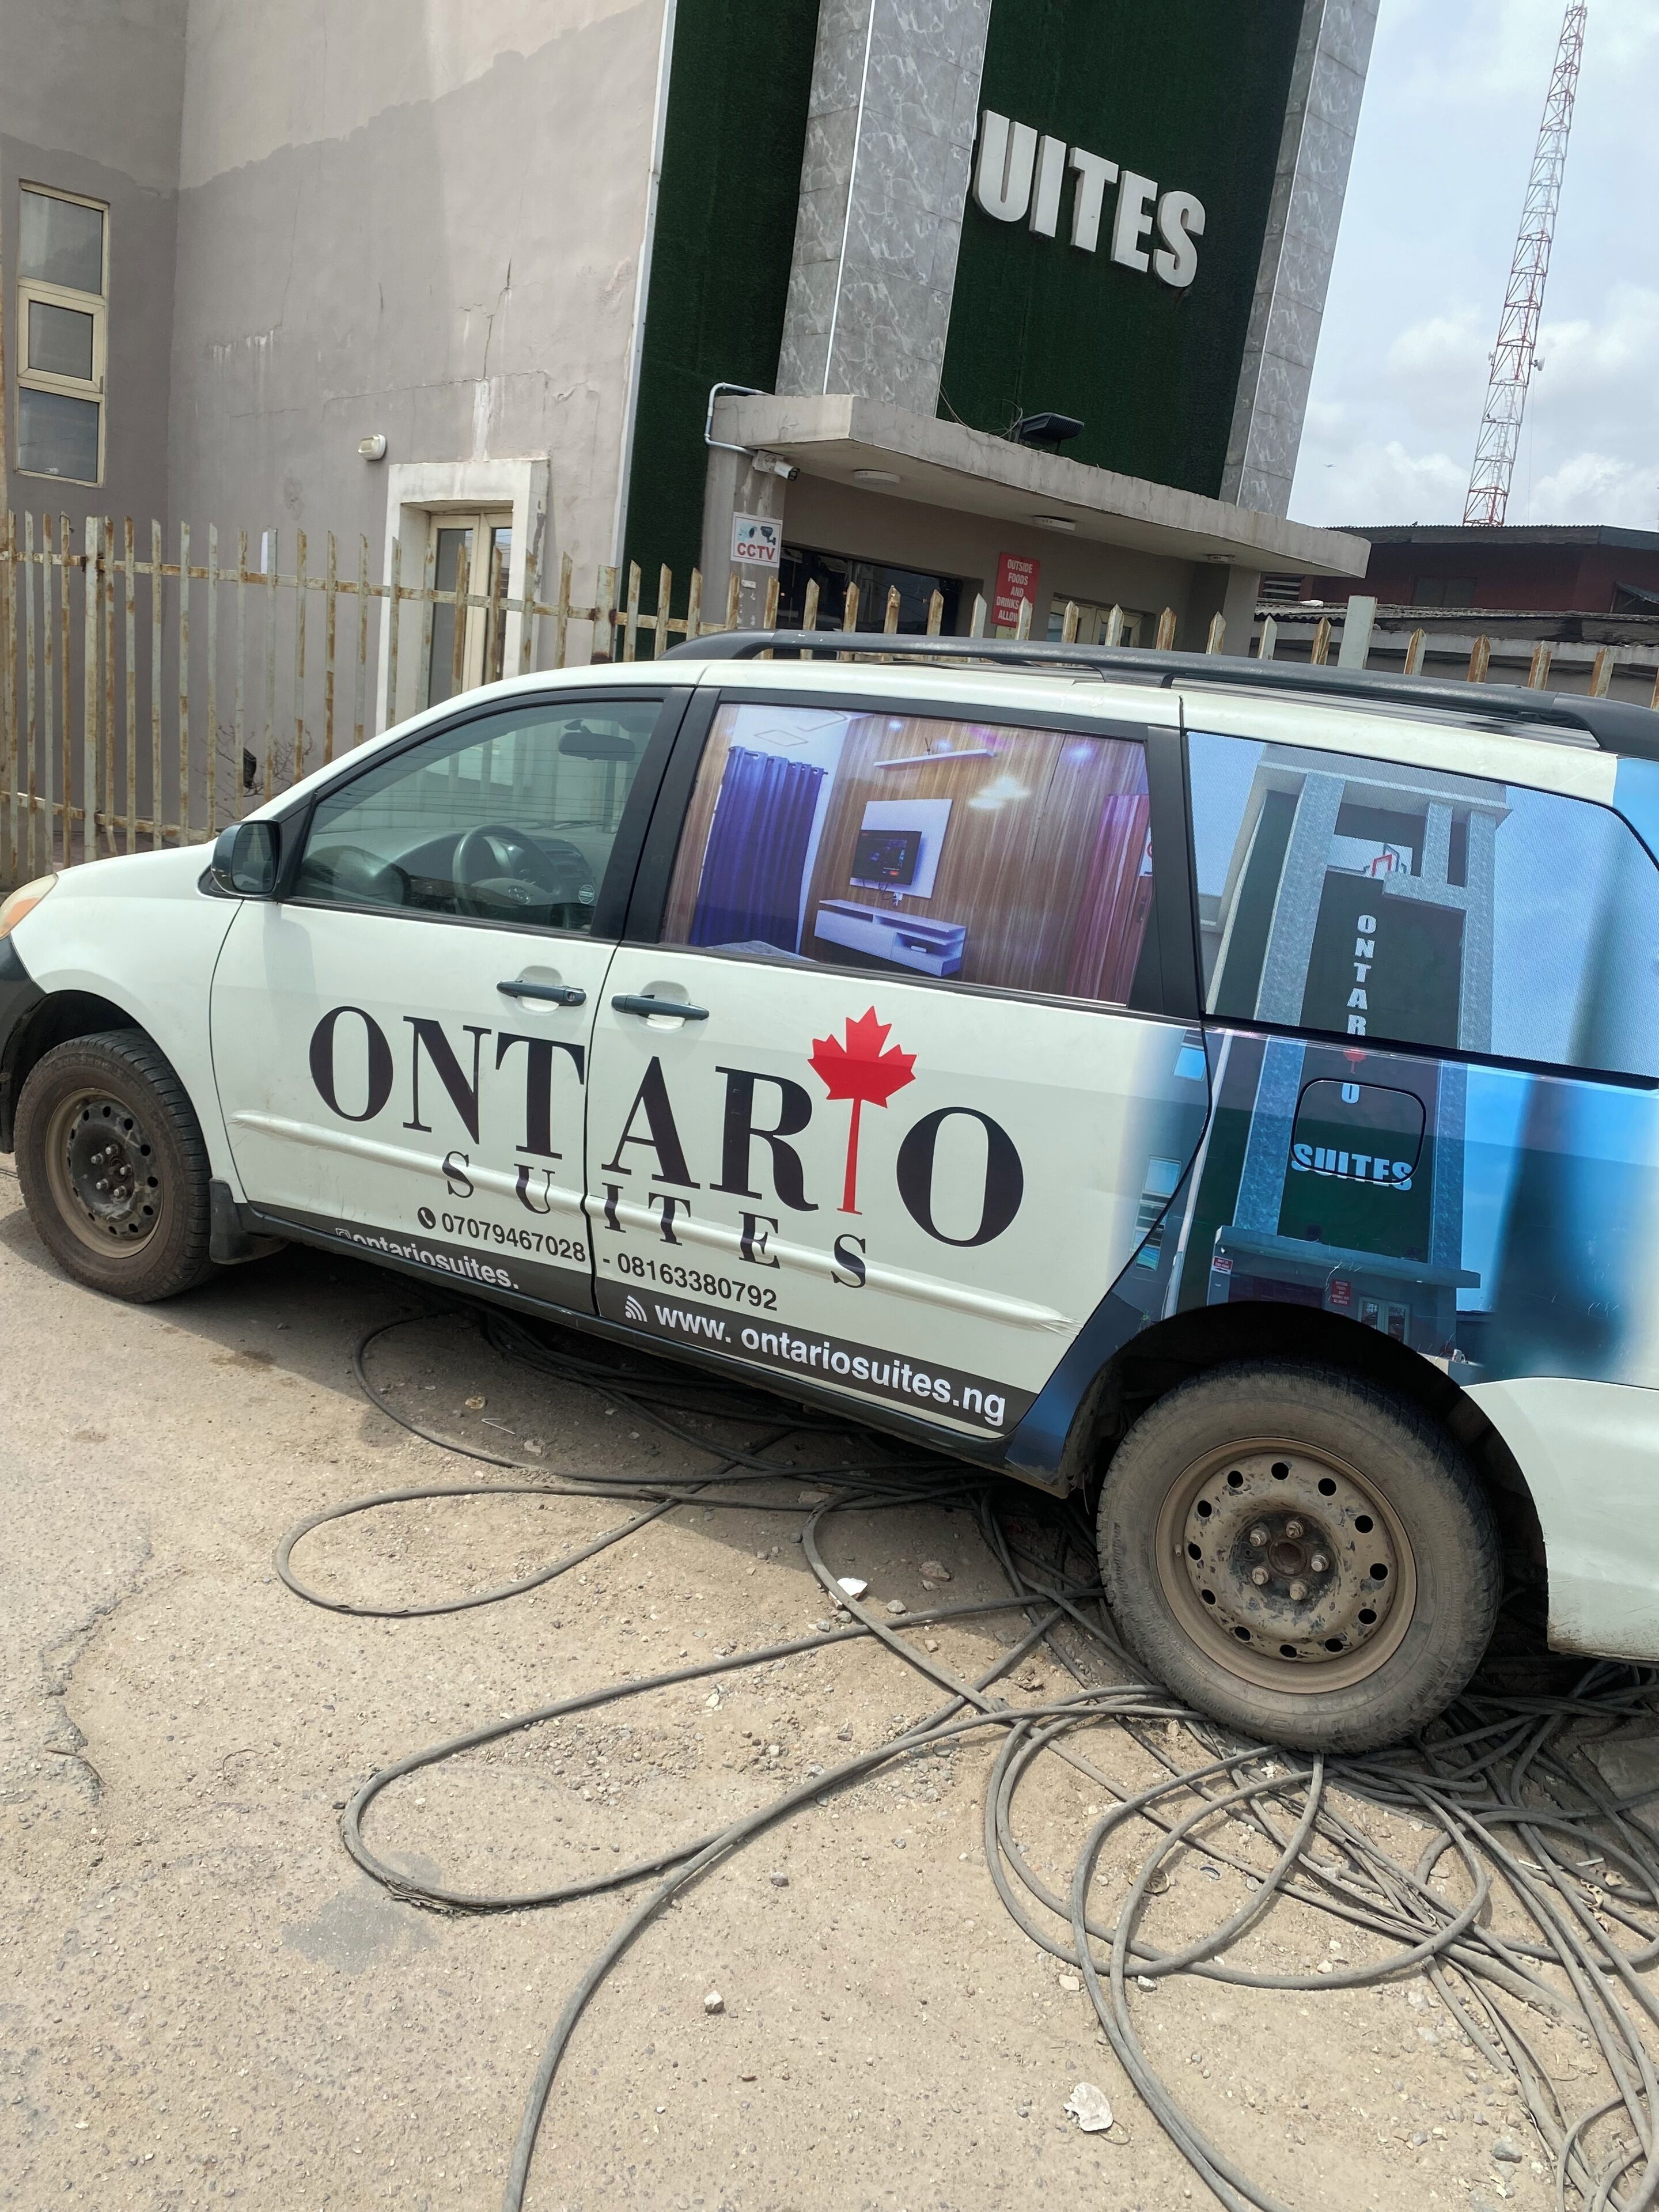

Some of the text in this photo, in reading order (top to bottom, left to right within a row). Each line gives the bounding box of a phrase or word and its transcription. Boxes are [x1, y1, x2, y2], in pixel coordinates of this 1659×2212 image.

[971, 109, 1206, 287] UITES
[737, 542, 775, 560] CCTV
[1007, 559, 1033, 574] OUTSIDE
[996, 596, 1020, 610] DRINKS
[1007, 572, 1029, 586] FOODS
[1010, 586, 1024, 598] AND
[309, 1006, 1024, 1248] ONTARIO
[1291, 1143, 1413, 1191] SUITES
[441, 1150, 866, 1289] SUITES
[442, 1213, 586, 1262] 07079467028
[618, 1253, 777, 1311] 08163380792
[654, 1305, 1006, 1427] www. ontariosuites.ng
